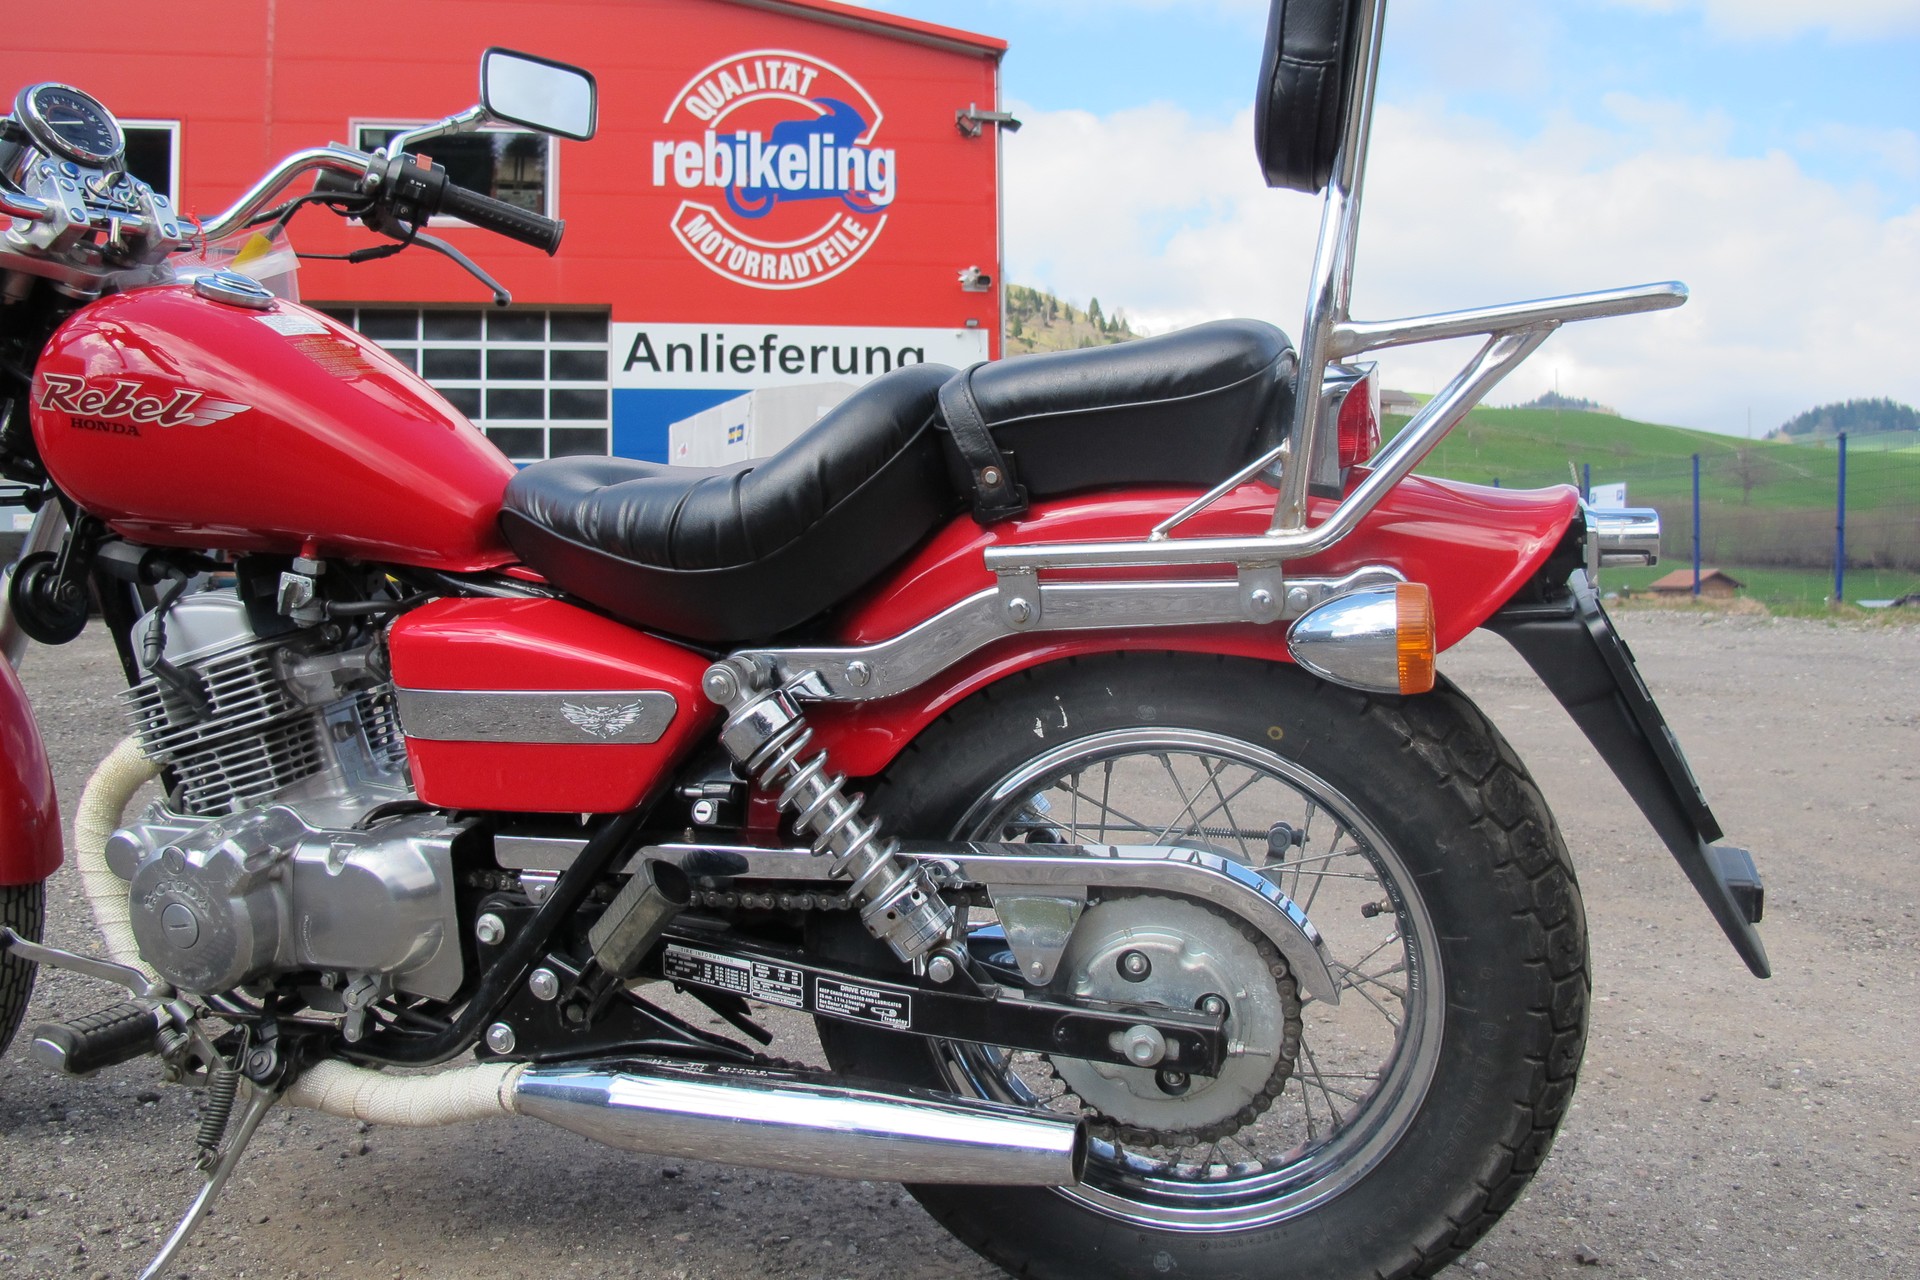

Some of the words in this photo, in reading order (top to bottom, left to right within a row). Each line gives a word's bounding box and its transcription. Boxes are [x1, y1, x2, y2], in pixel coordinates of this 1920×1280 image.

[684, 60, 818, 121] QUALITÄT
[652, 131, 896, 206] rebikeling
[682, 213, 869, 281] MOTORRADTEILE
[39, 372, 205, 428] Rebel
[70, 417, 142, 437] HONDA
[680, 947, 693, 955] TIRE
[695, 951, 734, 964] INFORMATION
[840, 984, 859, 994] DRIVE
[860, 988, 880, 998] CHAIN
[883, 1016, 908, 1026] freeplay
